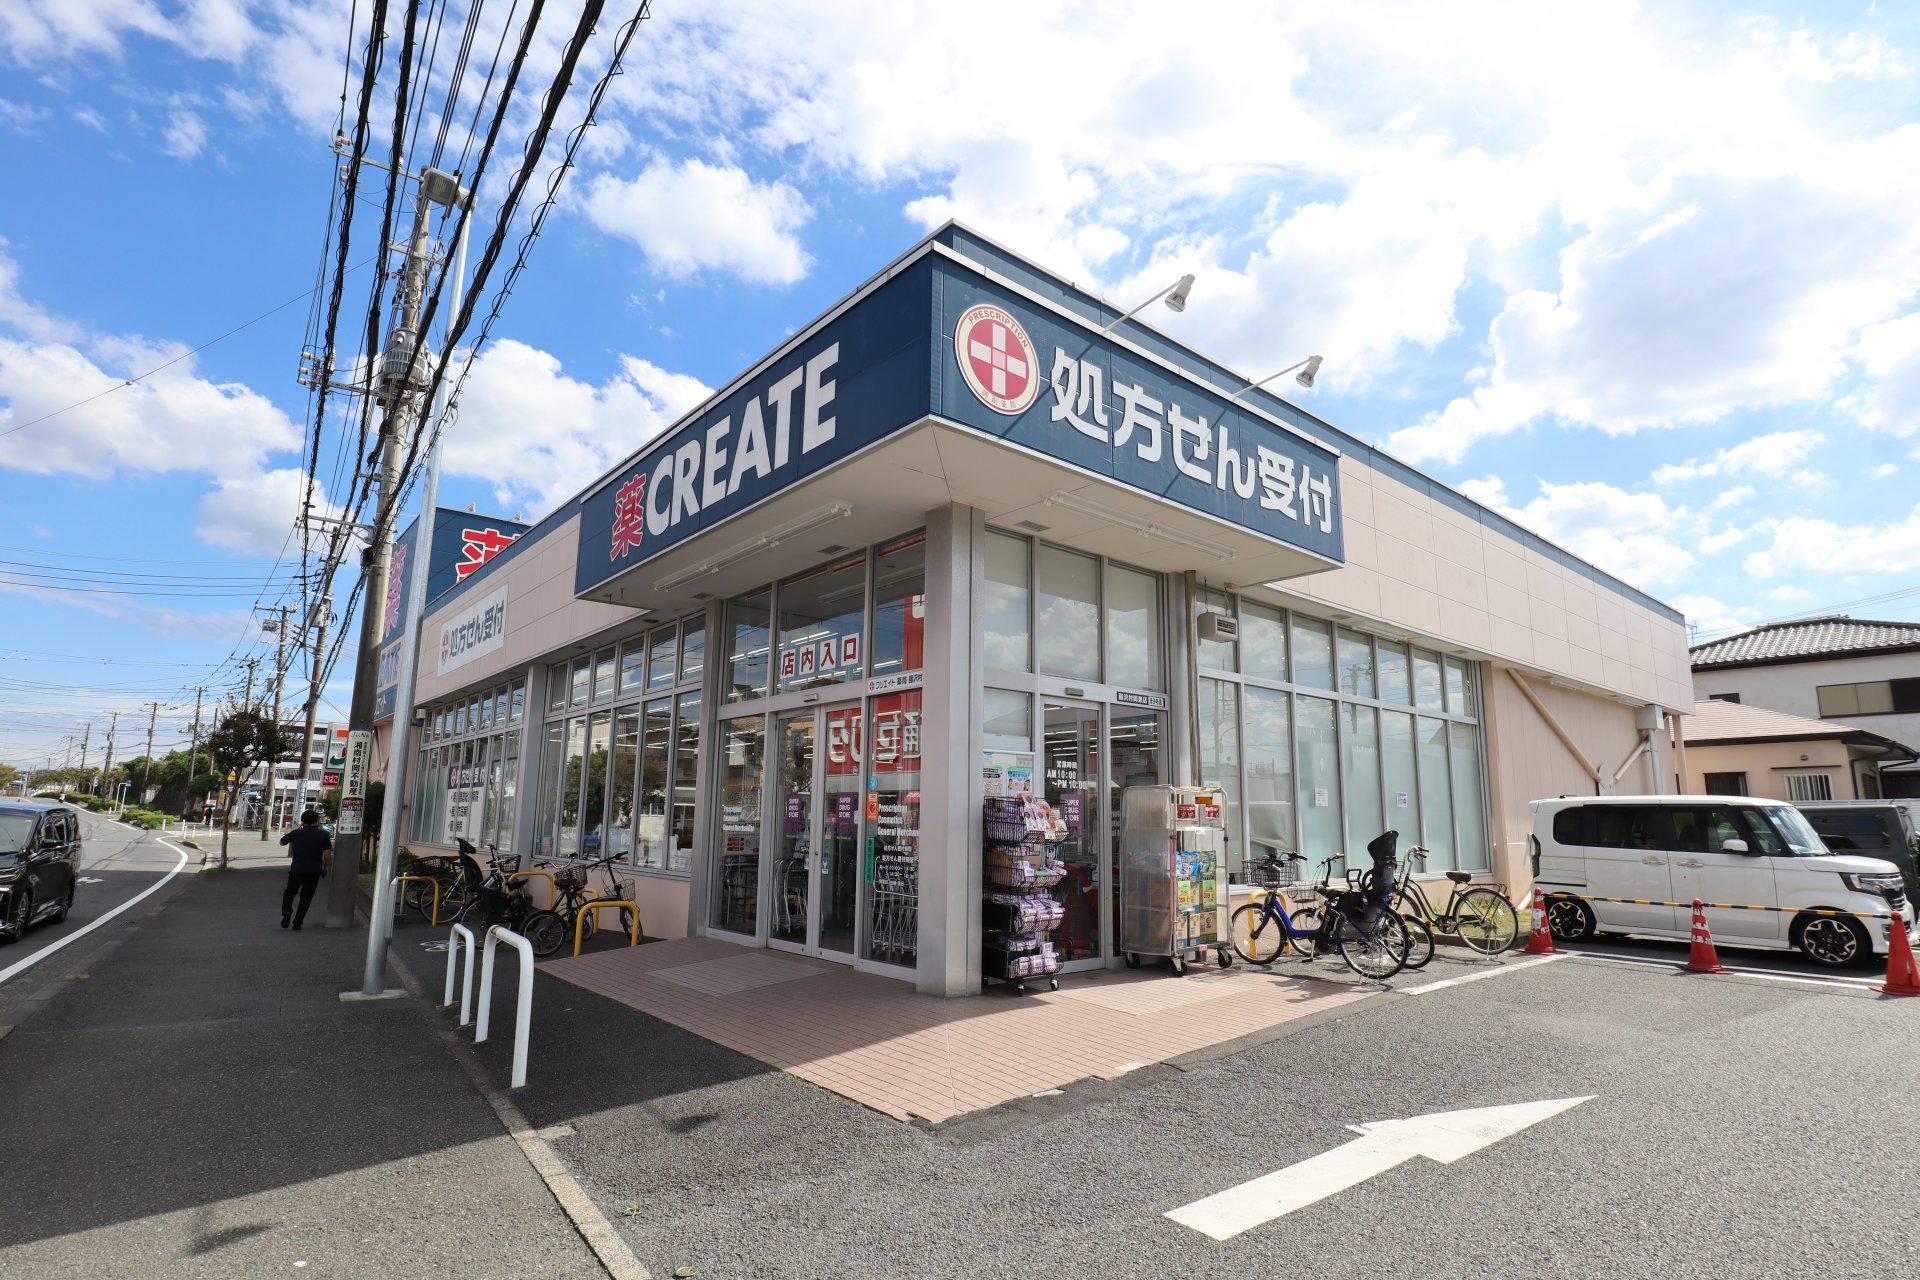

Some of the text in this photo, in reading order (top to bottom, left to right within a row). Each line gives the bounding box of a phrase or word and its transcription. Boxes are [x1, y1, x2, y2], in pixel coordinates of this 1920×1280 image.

[968, 309, 1028, 348] PRESCRIPTION
[1051, 346, 1332, 534] 処方せん受付
[609, 341, 840, 562] 薬 CREATE
[449, 599, 505, 659] 処方せん受付
[781, 637, 857, 676] 店内入口
[875, 679, 896, 690] クリエイト
[349, 741, 363, 796] 湘南村岡不動産
[1046, 769, 1077, 779] AM 10:00
[324, 774, 339, 783] たばこ
[1068, 781, 1087, 790] 10:00
[878, 803, 908, 813] Prescription
[878, 816, 903, 824] Cosmetics
[877, 827, 897, 836] General
